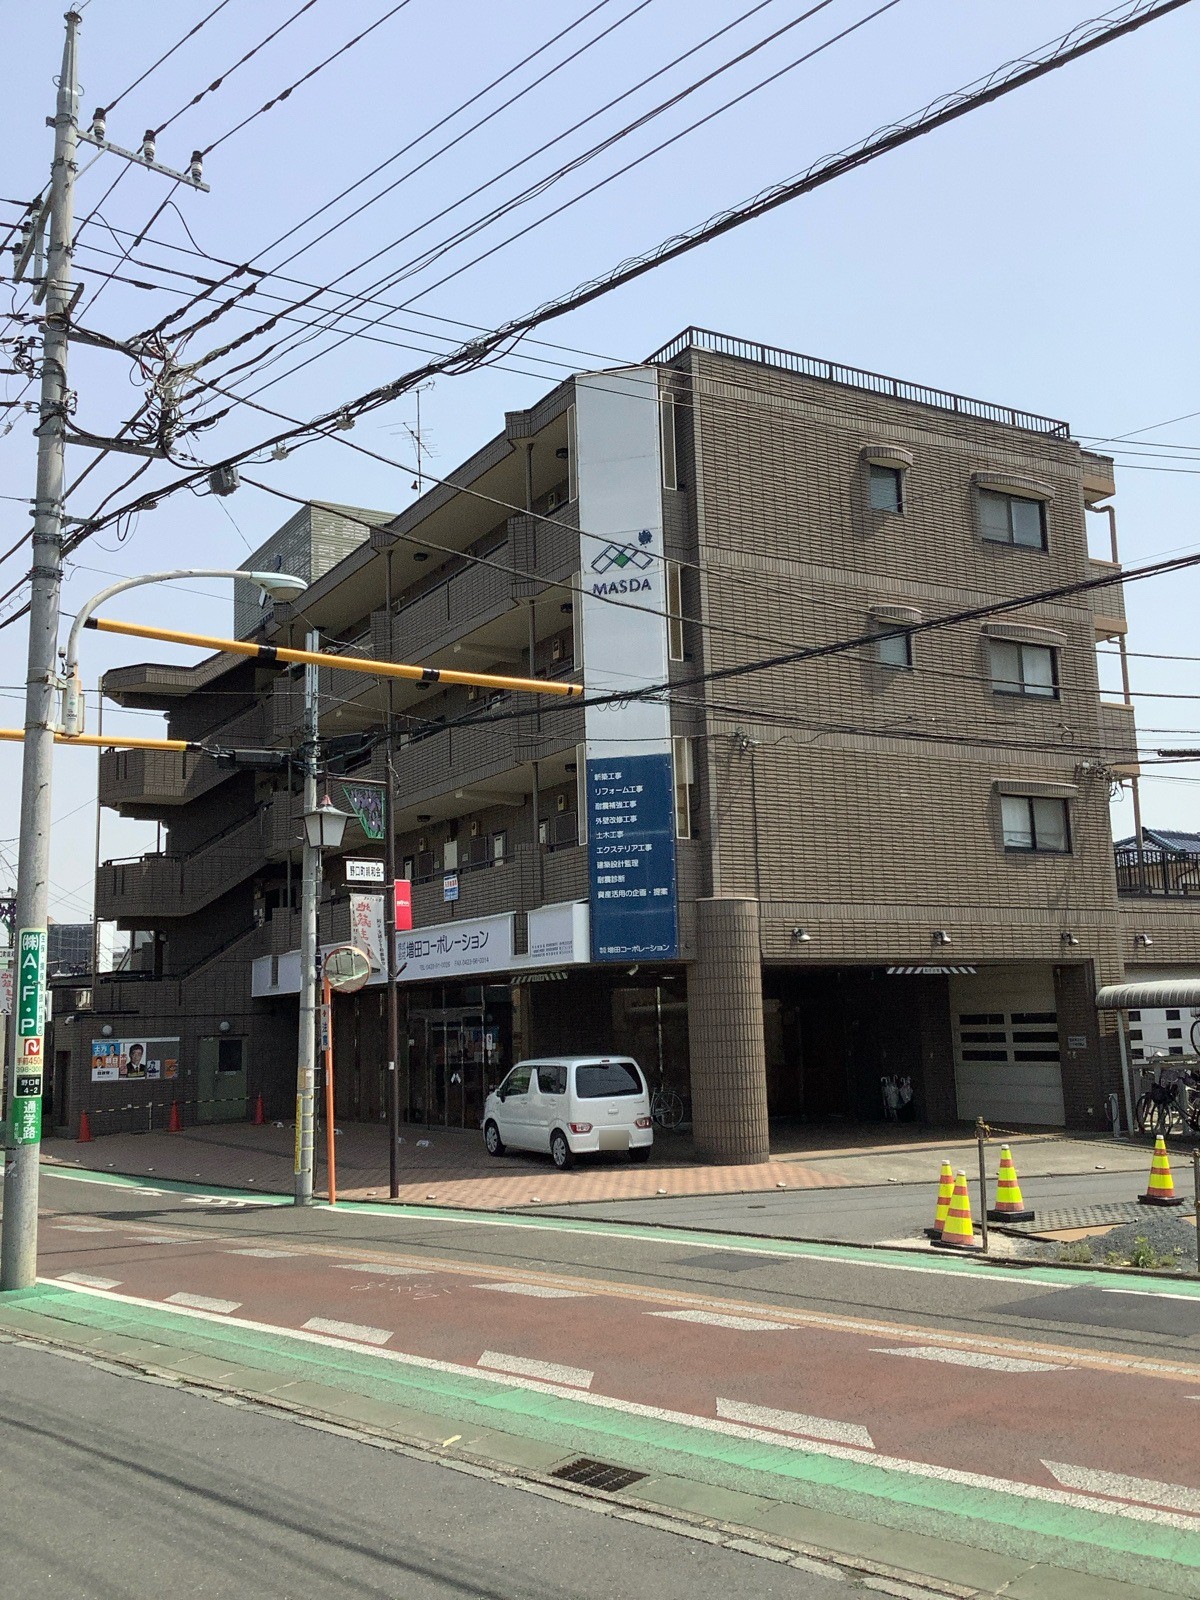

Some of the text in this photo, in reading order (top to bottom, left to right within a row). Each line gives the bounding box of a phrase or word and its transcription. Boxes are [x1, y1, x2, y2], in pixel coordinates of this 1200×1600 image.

[593, 578, 652, 595] MASDA
[594, 772, 622, 781] 新築工事
[595, 785, 643, 796] リフォーム工事
[595, 800, 637, 810] 耐震補強工事
[595, 815, 637, 825] 外壁改修工事
[596, 830, 624, 840] 土木工事
[596, 843, 652, 854] エクステリア工事
[597, 859, 639, 869] 建築設計監理
[597, 875, 626, 884] 耐震診断
[597, 887, 669, 899] 資産活用の企画・提案
[406, 931, 489, 961] 増田コーポレーション
[23, 1101, 37, 1140] 通学路
